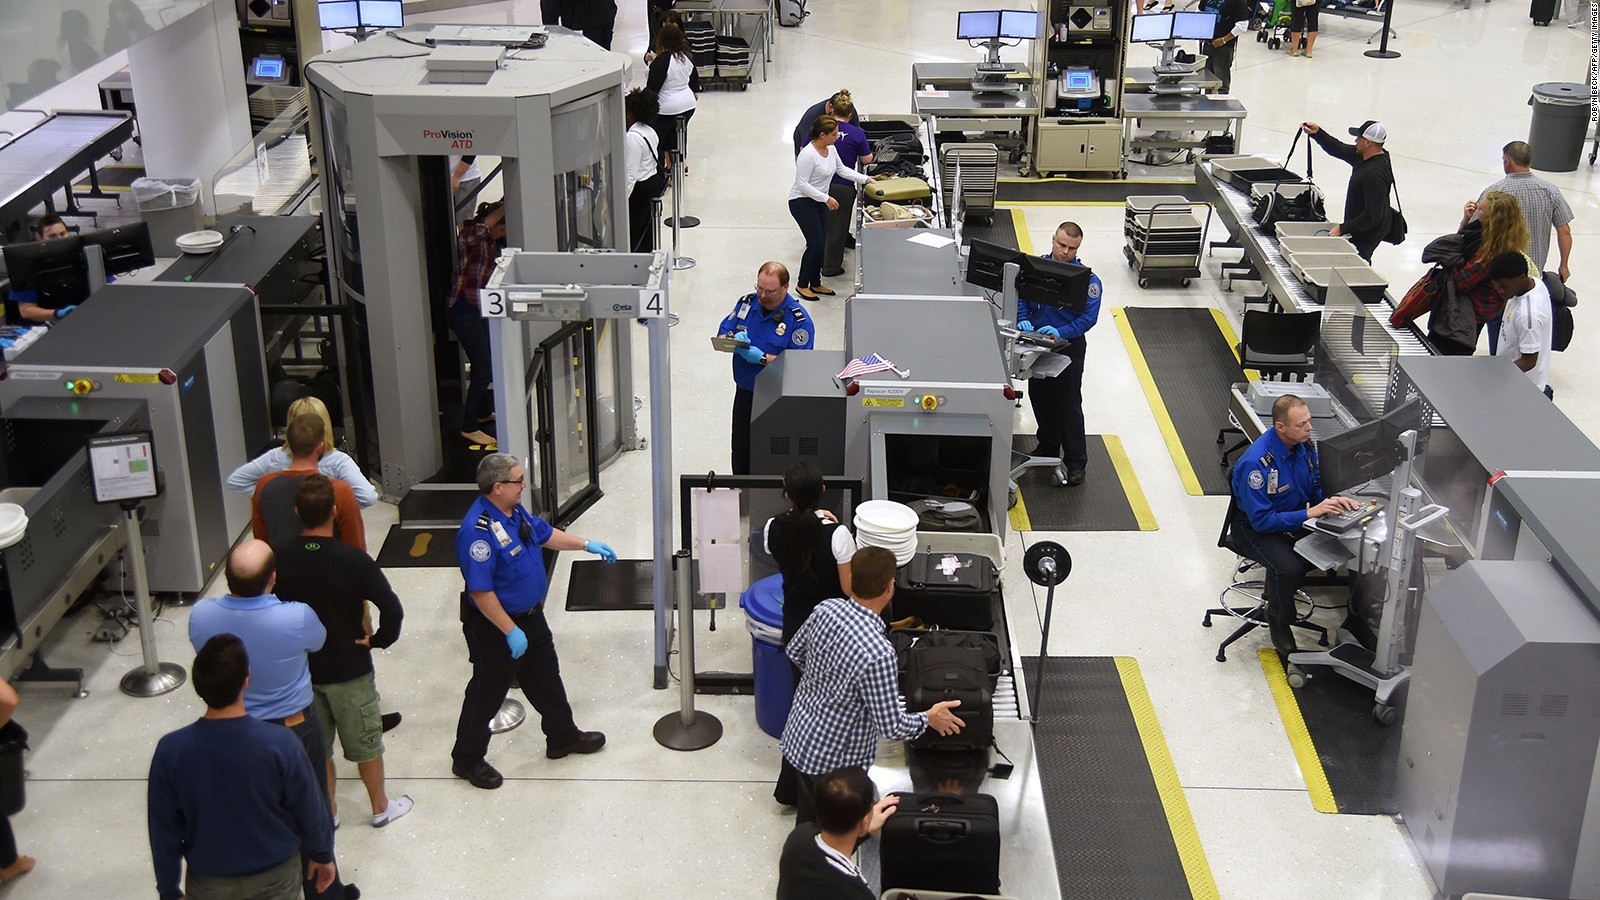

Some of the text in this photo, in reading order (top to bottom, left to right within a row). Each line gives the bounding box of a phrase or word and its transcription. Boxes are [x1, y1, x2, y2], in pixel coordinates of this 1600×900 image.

[423, 130, 473, 139] ProVision
[451, 140, 473, 149] ATD
[487, 292, 504, 315] 3
[646, 292, 663, 316] 4
